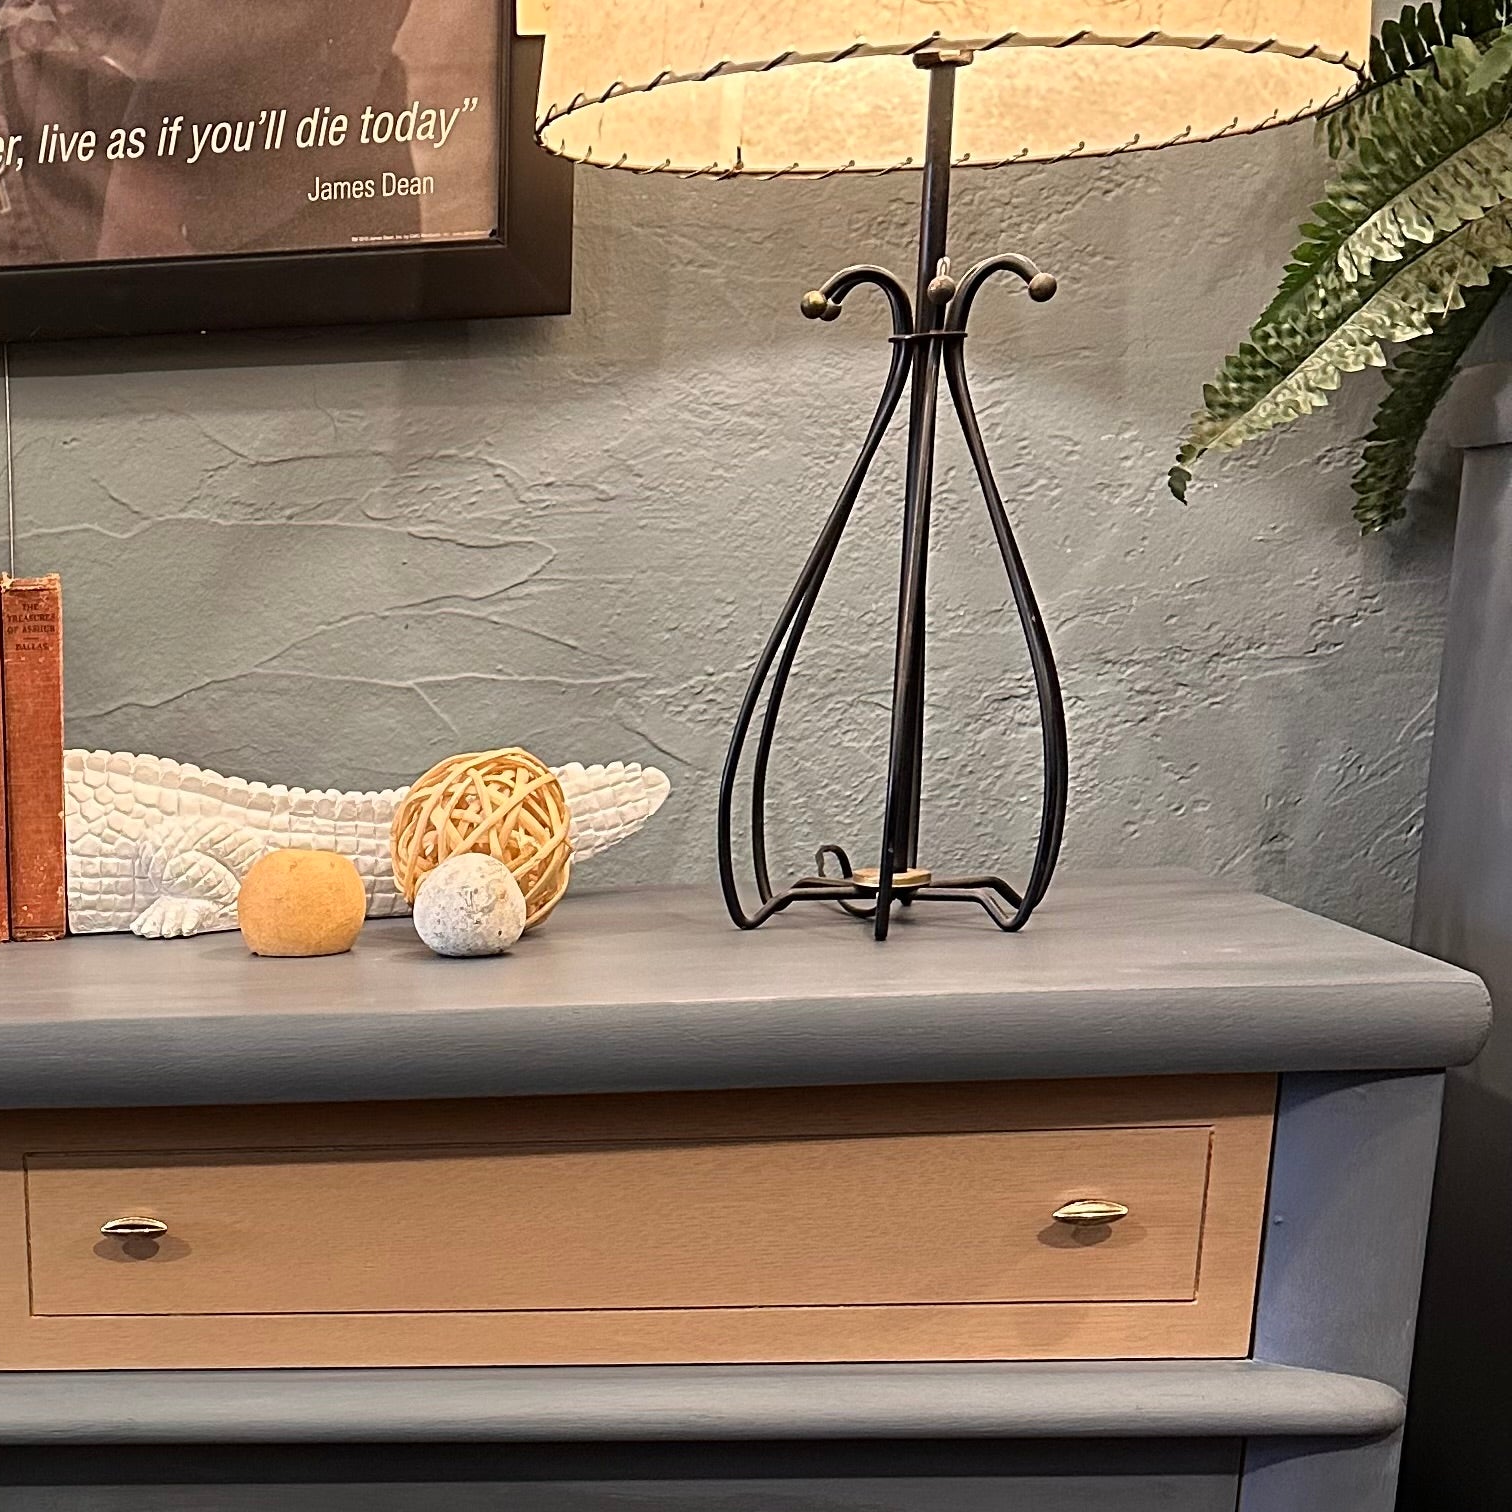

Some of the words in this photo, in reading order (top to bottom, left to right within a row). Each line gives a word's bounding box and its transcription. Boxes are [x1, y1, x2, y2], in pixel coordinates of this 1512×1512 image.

[38, 123, 97, 164] live
[106, 125, 146, 160] as
[157, 115, 184, 157] if
[186, 109, 287, 164] you’ll
[295, 106, 348, 149] die
[360, 96, 479, 149] today”
[307, 176, 375, 202] James
[381, 172, 435, 197] Dean
[21, 603, 40, 611] THE
